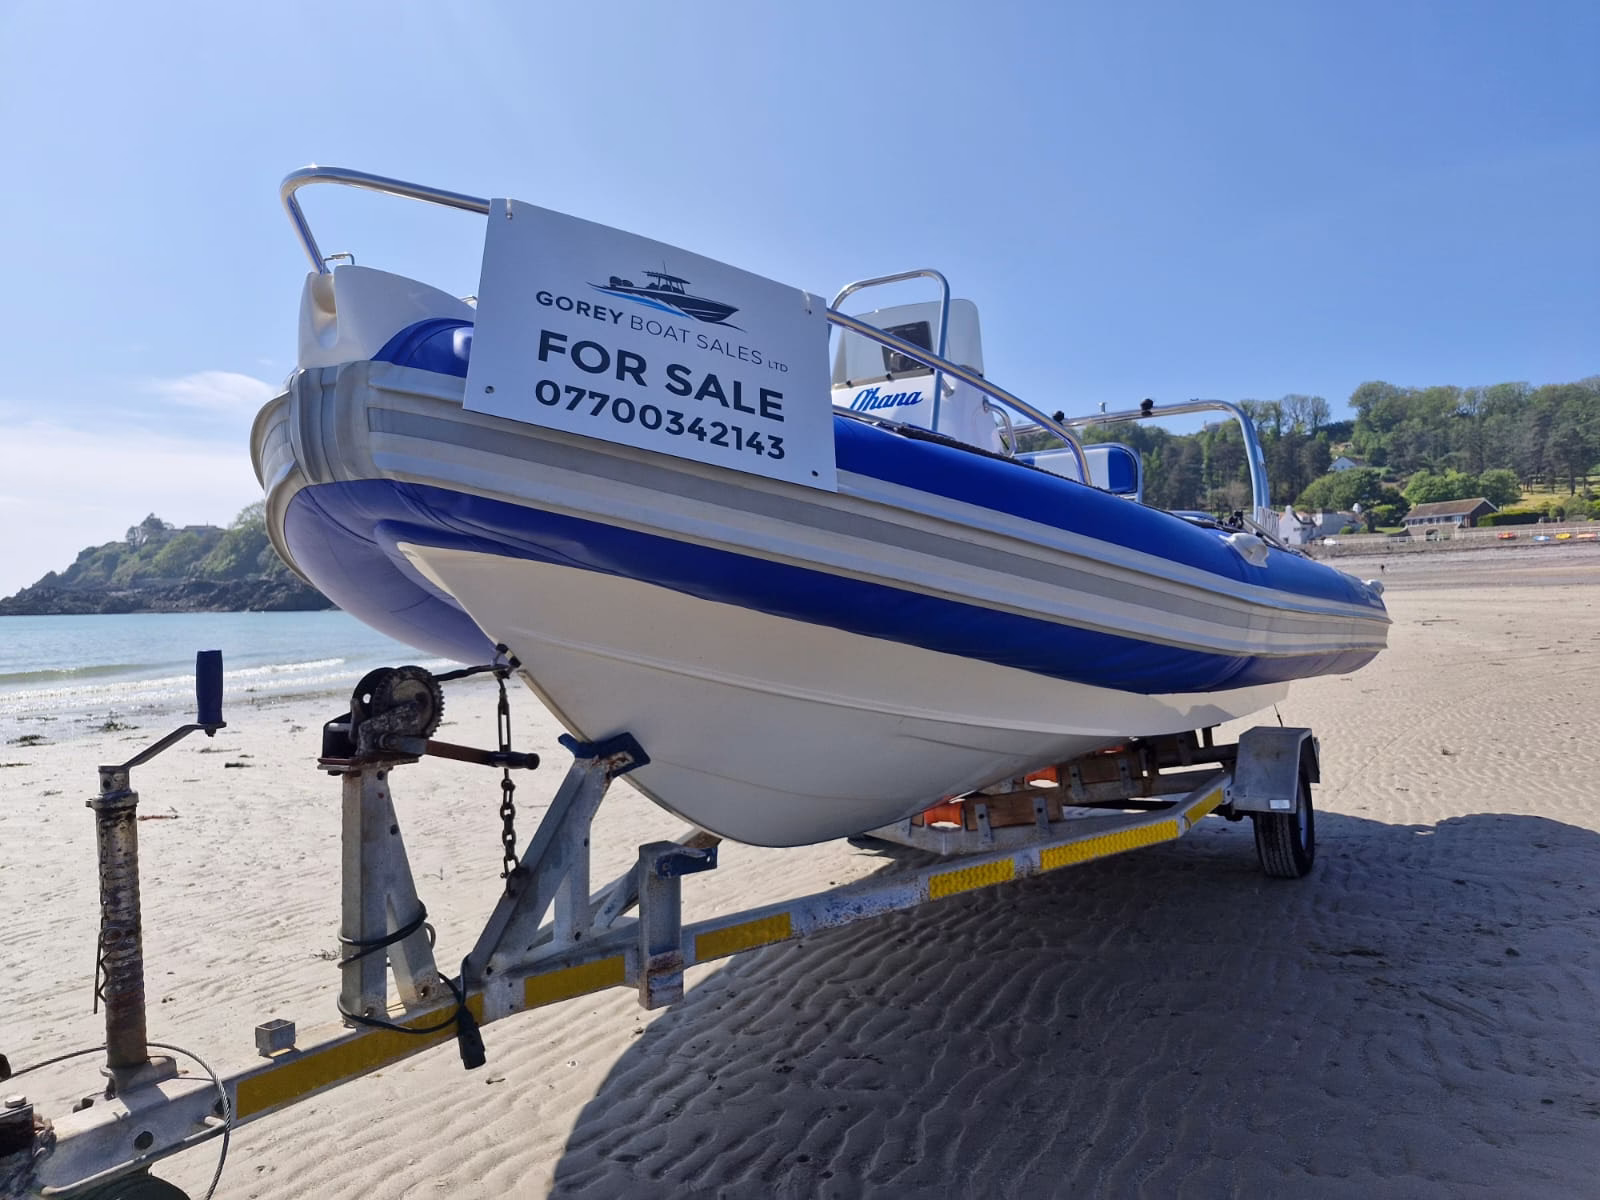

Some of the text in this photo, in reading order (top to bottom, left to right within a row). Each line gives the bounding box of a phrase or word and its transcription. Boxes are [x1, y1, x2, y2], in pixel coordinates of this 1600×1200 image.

[536, 290, 788, 372] GOREY BOAT SALES LTD
[538, 330, 785, 422] FOR SALE
[535, 380, 785, 460] 07700342143
